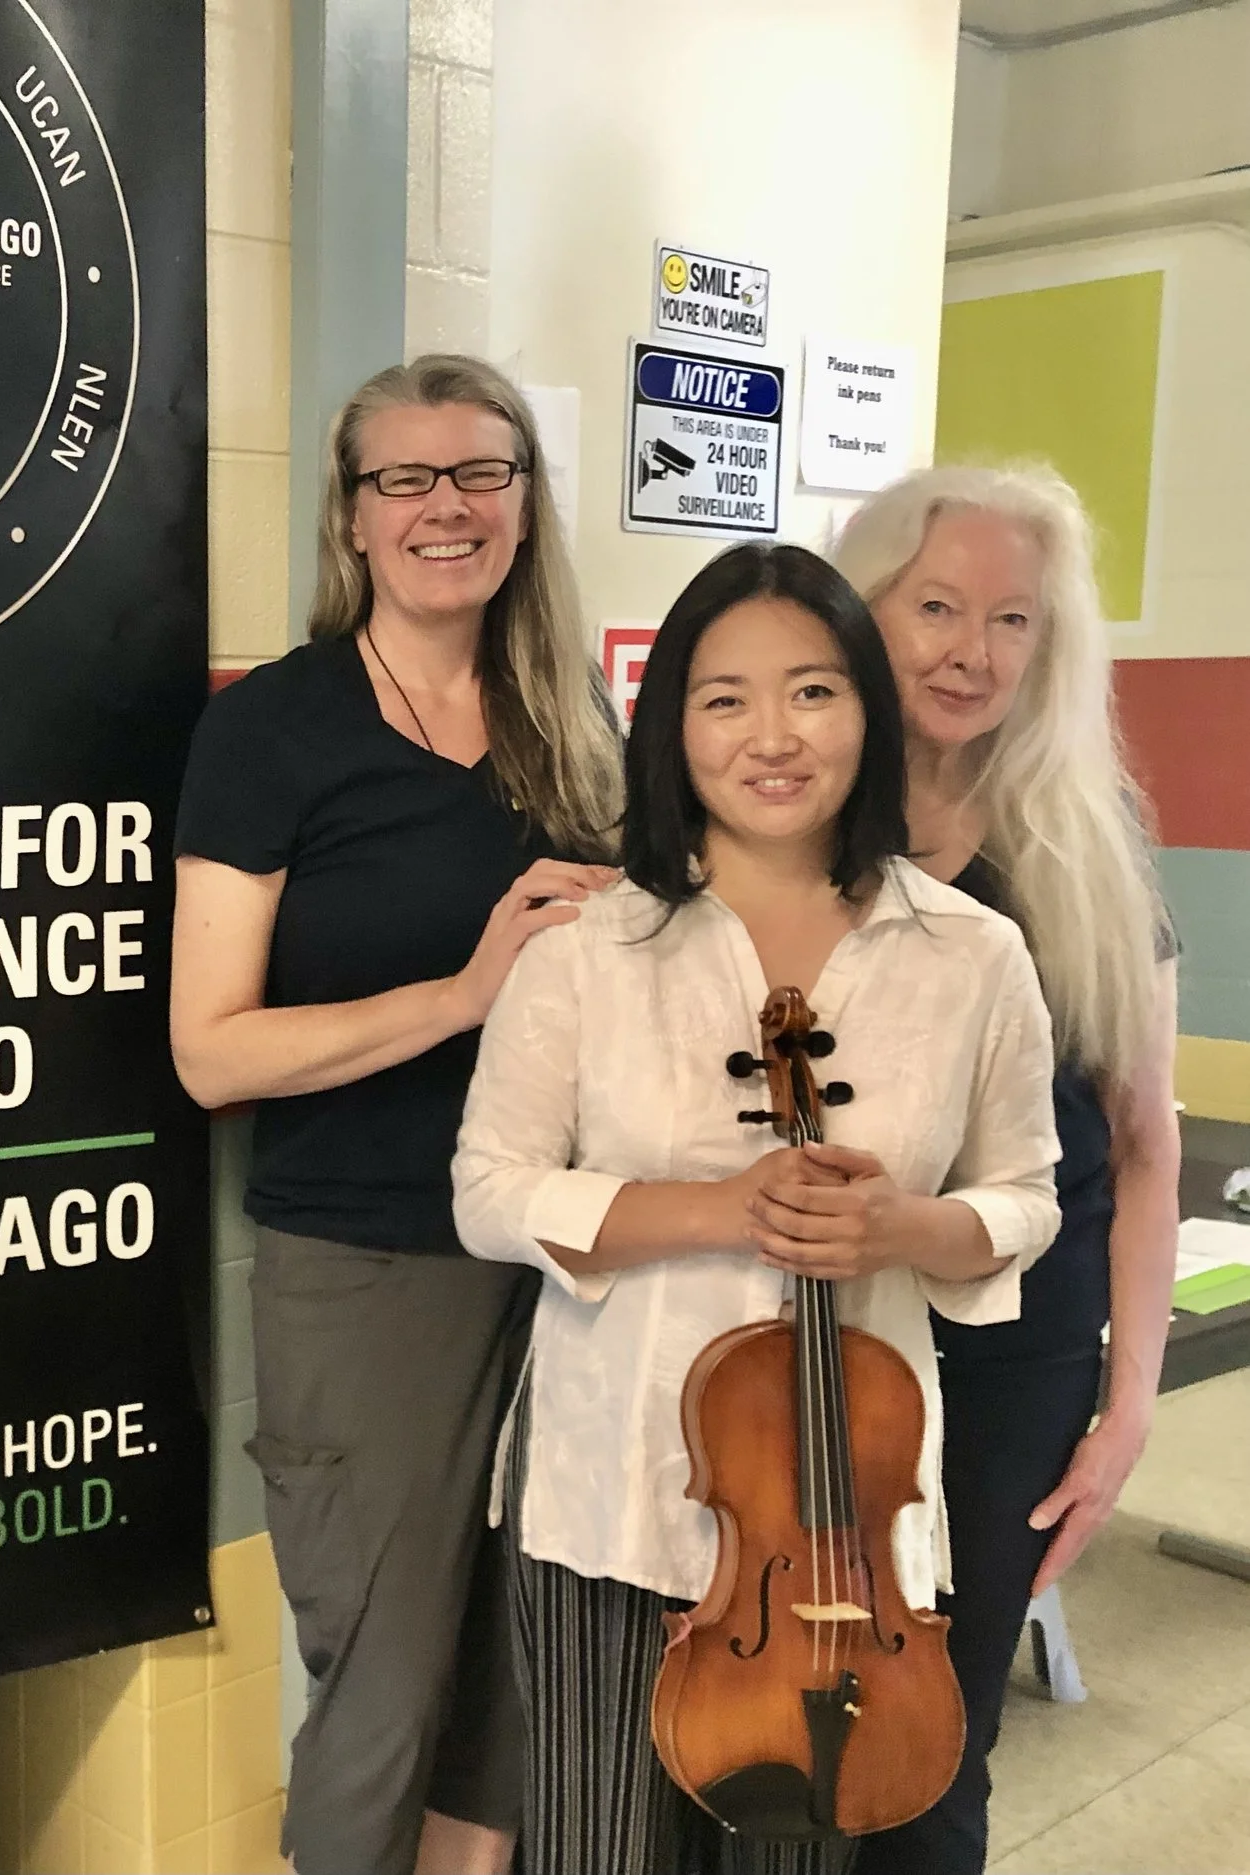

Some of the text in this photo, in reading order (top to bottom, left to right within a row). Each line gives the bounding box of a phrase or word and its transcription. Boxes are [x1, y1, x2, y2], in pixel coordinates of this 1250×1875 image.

[15, 65, 87, 188] UCAN
[690, 263, 741, 300] SMILE
[661, 297, 763, 337] YOU'RE ON CAMERA
[827, 356, 895, 379] Please return
[671, 362, 751, 408] NOTICE
[837, 384, 882, 404] ink pens
[50, 363, 108, 472] NLEN
[672, 415, 769, 443] THIS AREA IS UNDER
[706, 442, 767, 470] 24 HOUR
[828, 434, 886, 456] Thank you!
[715, 471, 758, 497] VIDEO
[678, 495, 766, 521] SURVEILLANCE
[0, 801, 153, 890] FOR
[4, 1402, 157, 1478] HOPE.
